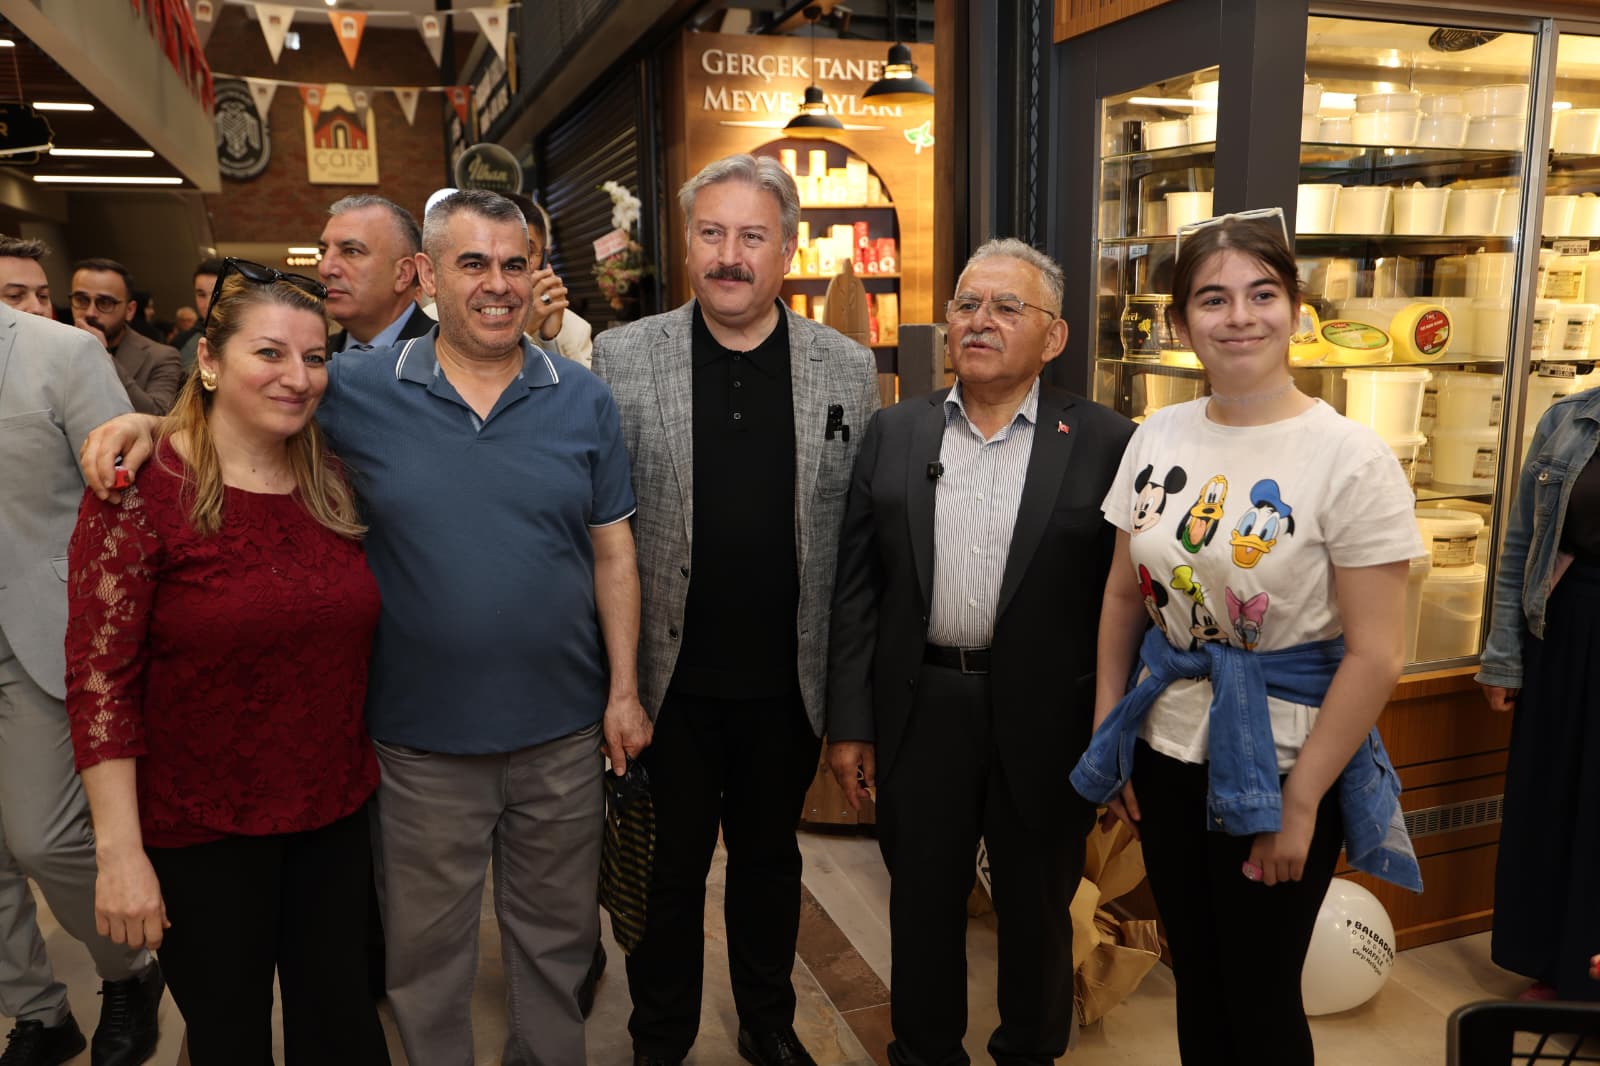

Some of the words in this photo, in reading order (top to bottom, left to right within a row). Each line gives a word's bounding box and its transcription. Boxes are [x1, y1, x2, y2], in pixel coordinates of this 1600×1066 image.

[702, 48, 810, 83] GERÇEK
[703, 85, 794, 115] MEYVE
[1362, 944, 1384, 966] WAFFLE
